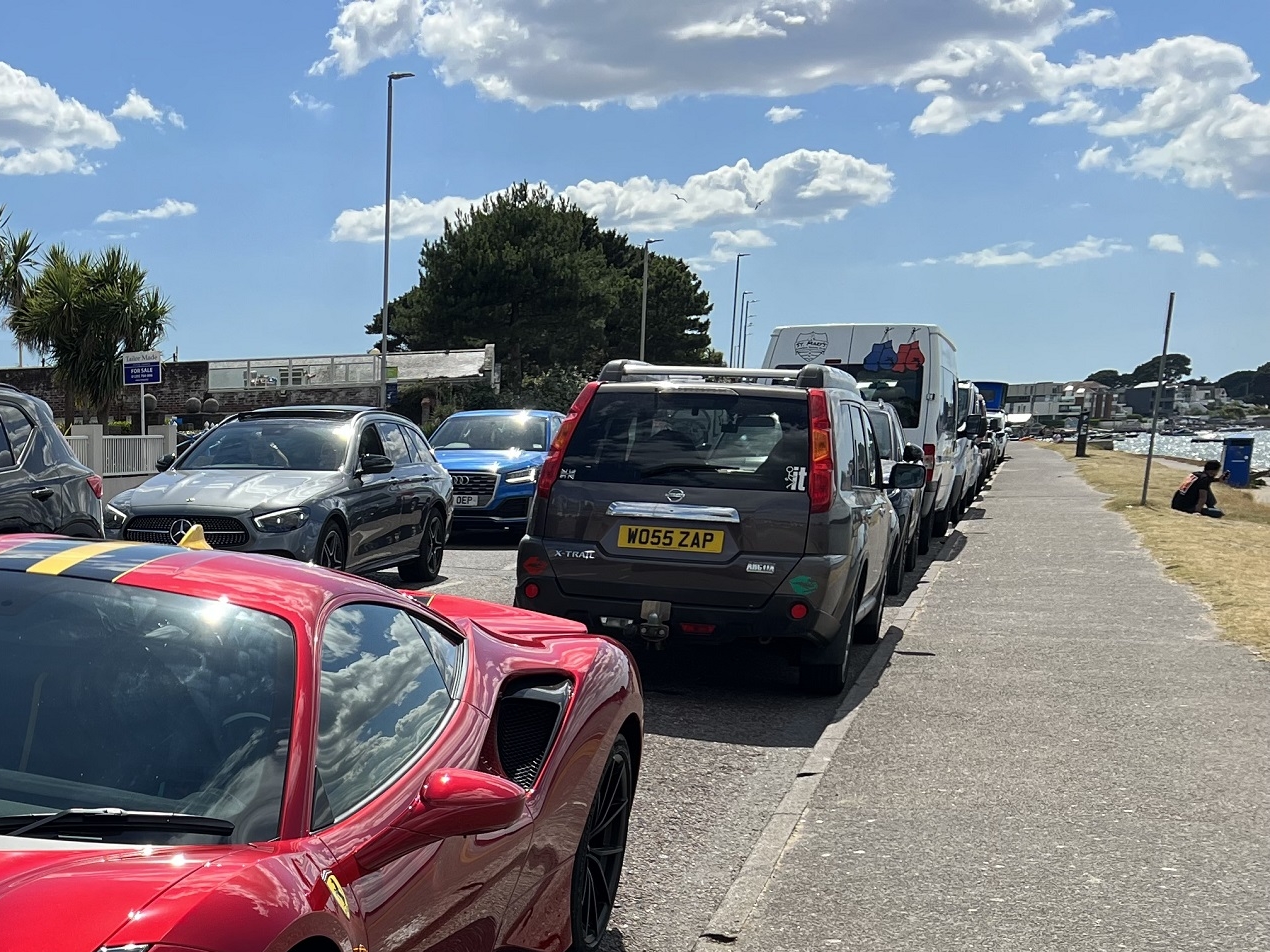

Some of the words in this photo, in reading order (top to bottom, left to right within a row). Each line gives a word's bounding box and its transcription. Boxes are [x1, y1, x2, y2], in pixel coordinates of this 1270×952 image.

[790, 466, 808, 491] it
[627, 528, 674, 547] WO55
[678, 531, 714, 549] ZAP
[554, 550, 595, 559] X-TRAIL
